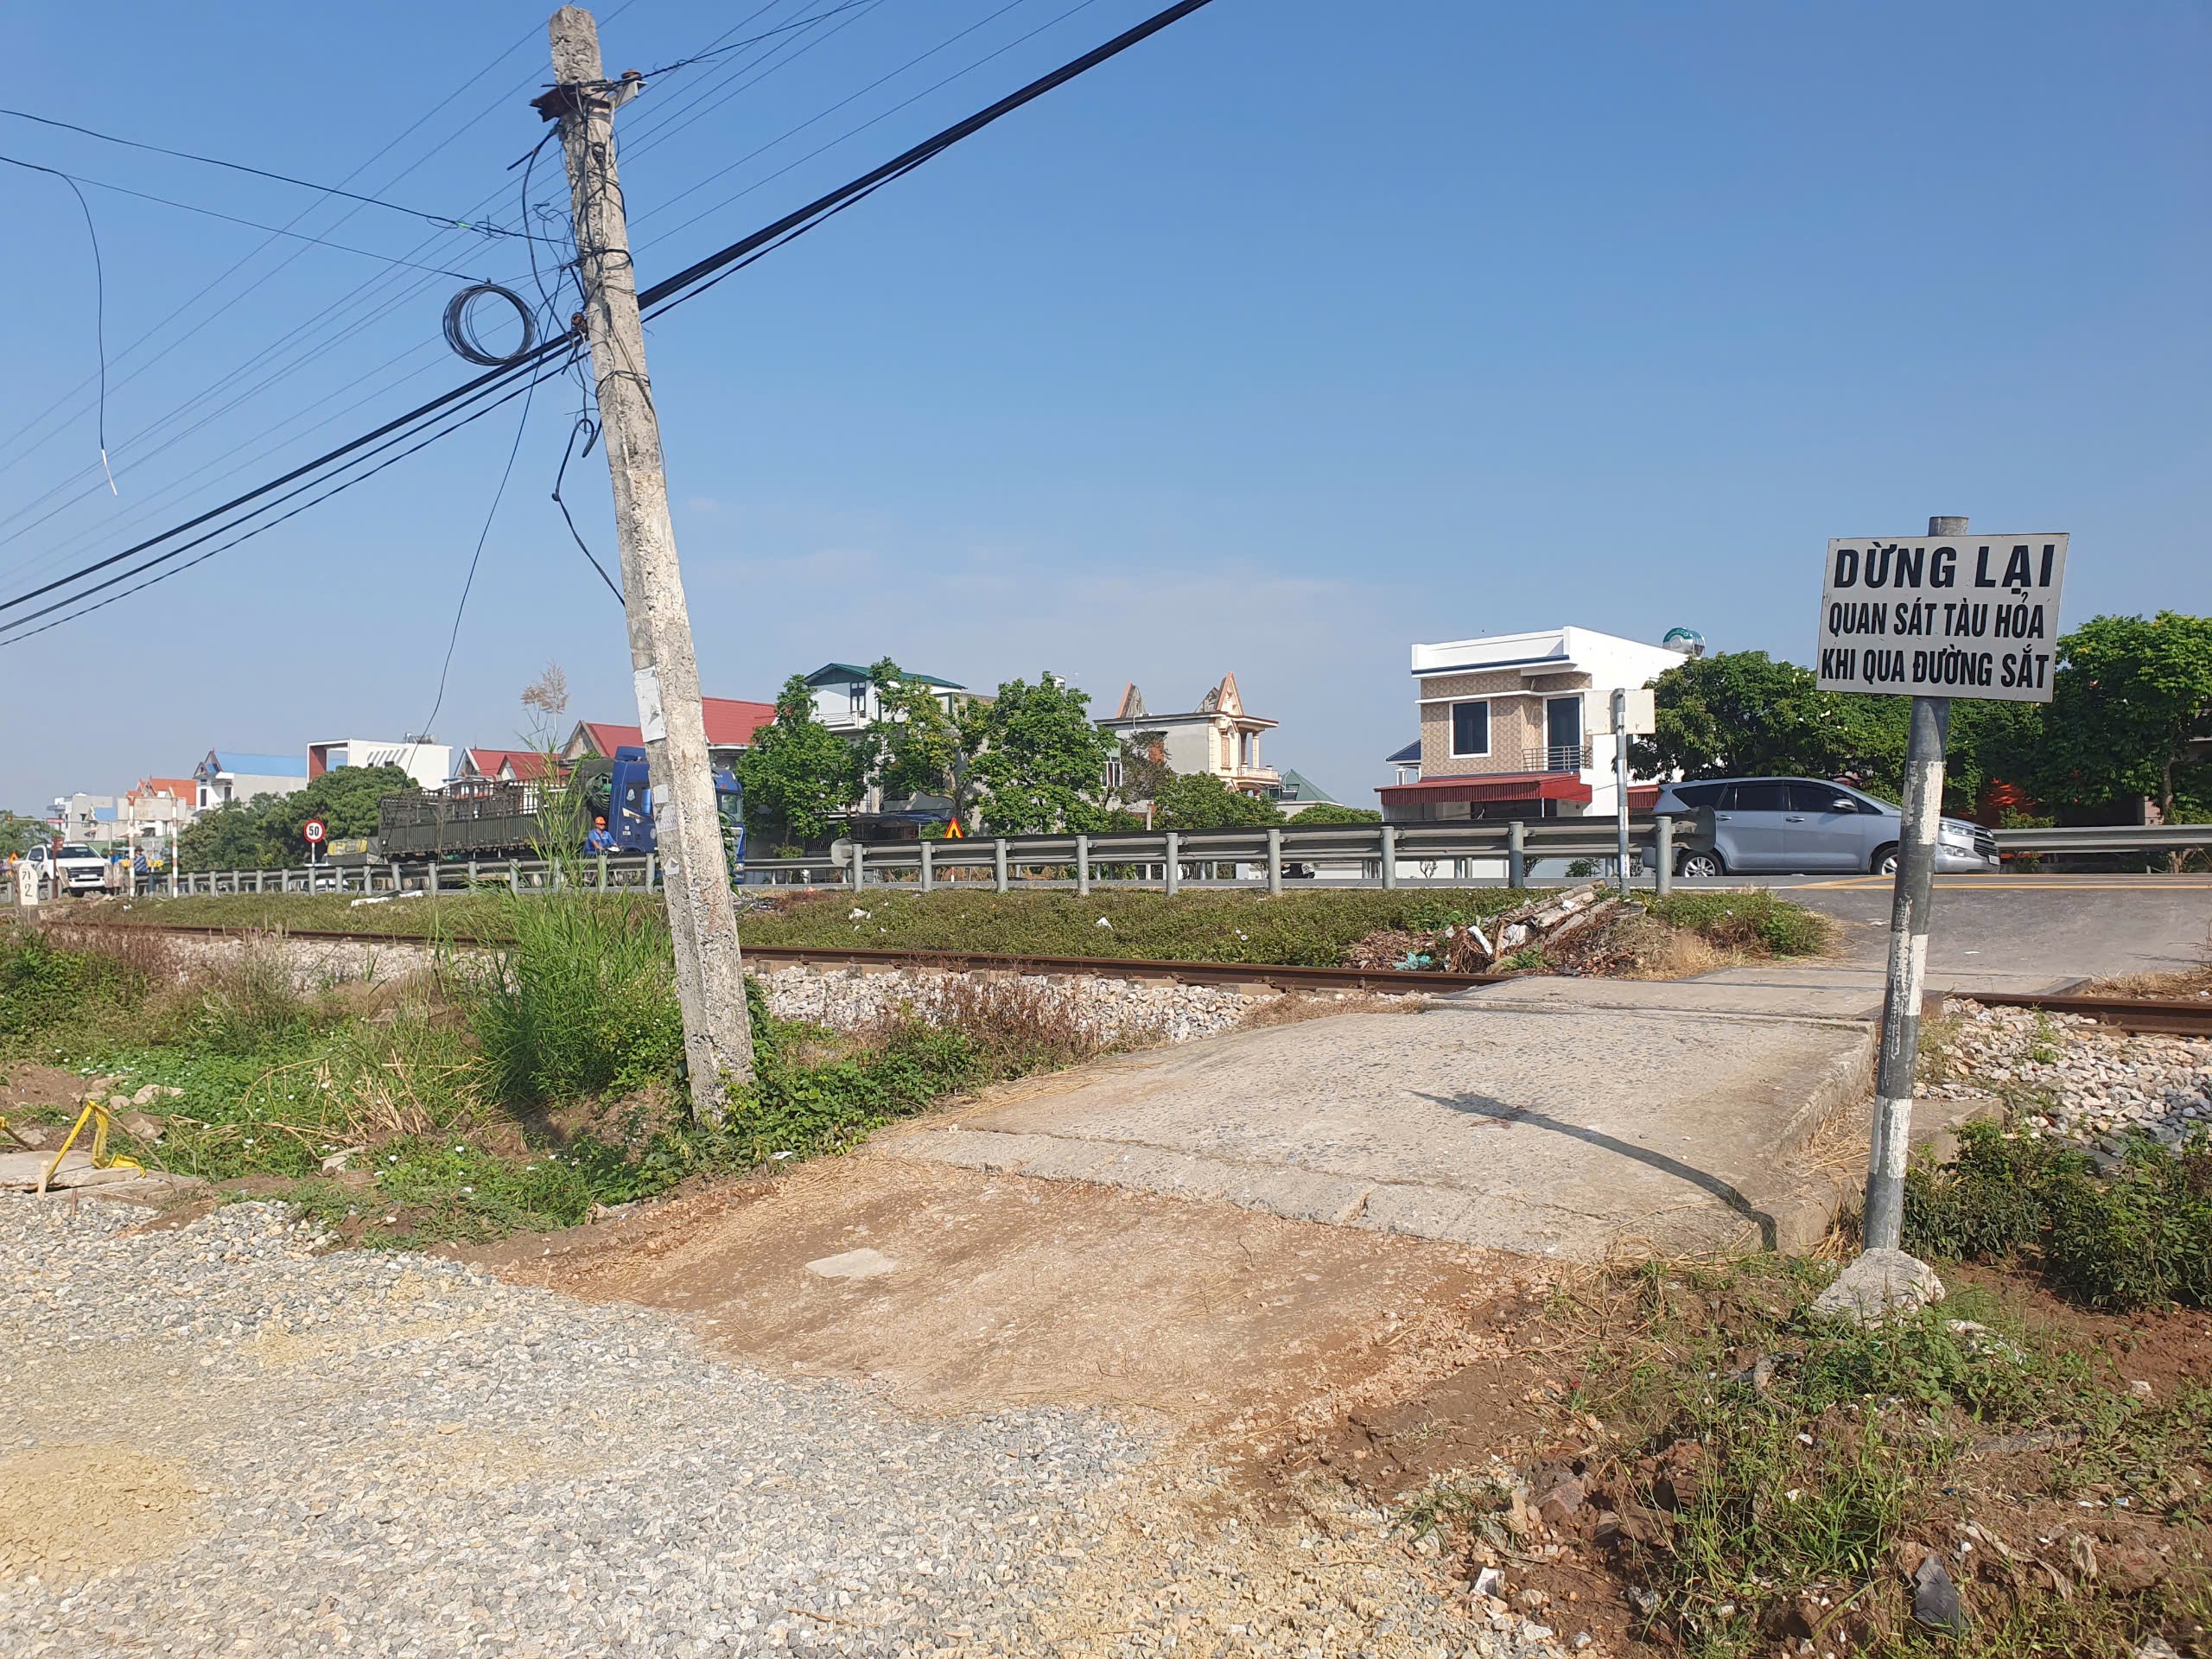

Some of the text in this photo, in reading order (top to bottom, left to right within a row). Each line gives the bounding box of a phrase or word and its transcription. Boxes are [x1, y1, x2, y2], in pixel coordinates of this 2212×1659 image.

[1834, 542, 2055, 594] DỪNG LẠI
[1828, 591, 2044, 639] QUAN SÁT TÀU HỎA
[1821, 644, 2050, 689] KHI QUA ĐƯỜNG SẮT
[308, 826, 319, 836] 50
[24, 883, 33, 897] 2
